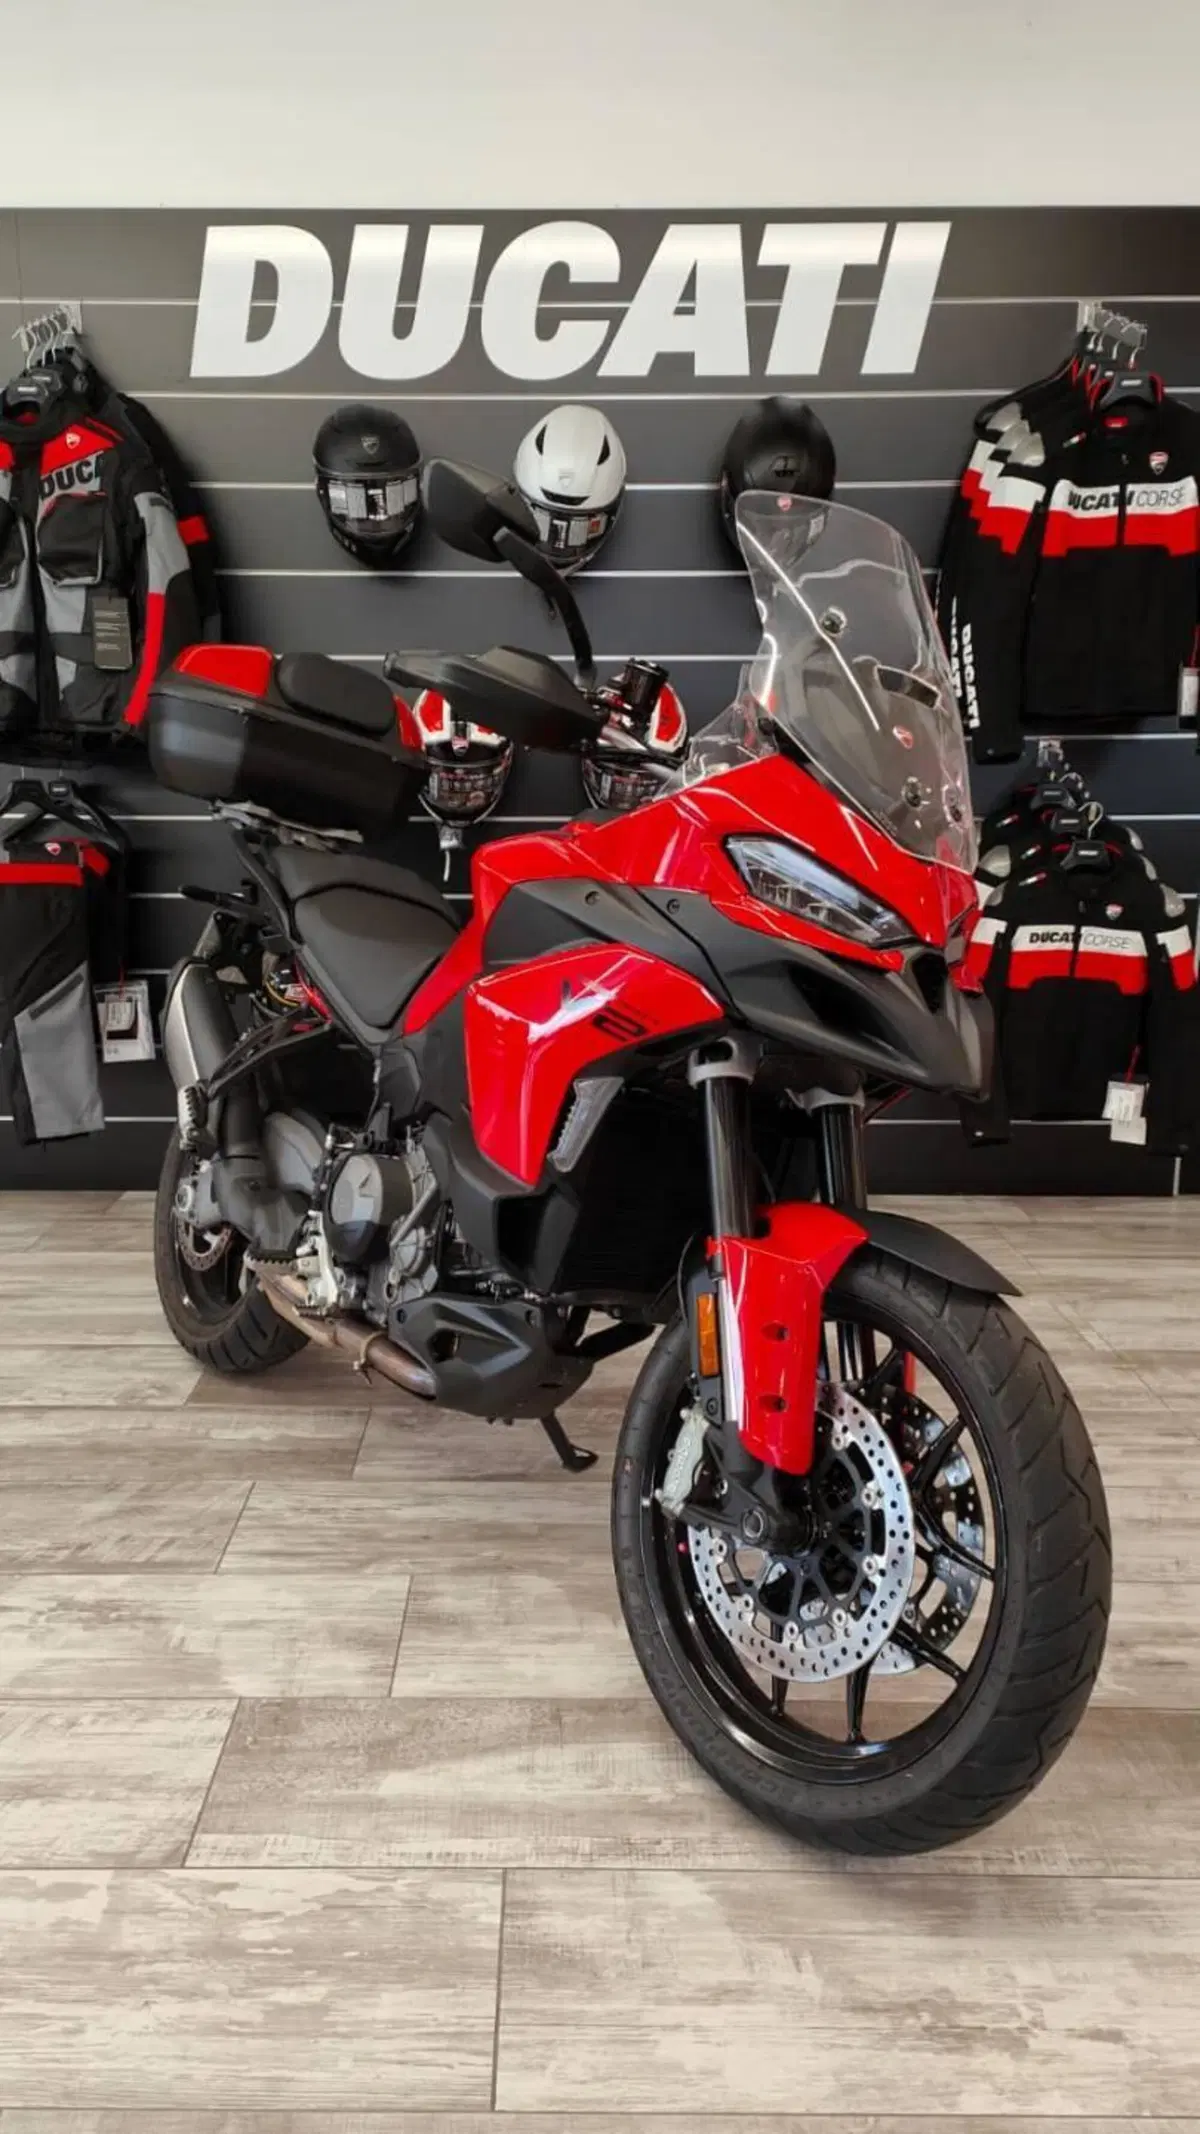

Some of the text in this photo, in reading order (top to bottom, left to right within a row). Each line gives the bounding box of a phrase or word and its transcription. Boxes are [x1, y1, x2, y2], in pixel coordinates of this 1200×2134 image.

[190, 220, 951, 380] DUCATI
[961, 623, 980, 729] DUCATI
[1083, 932, 1131, 949] CORSE
